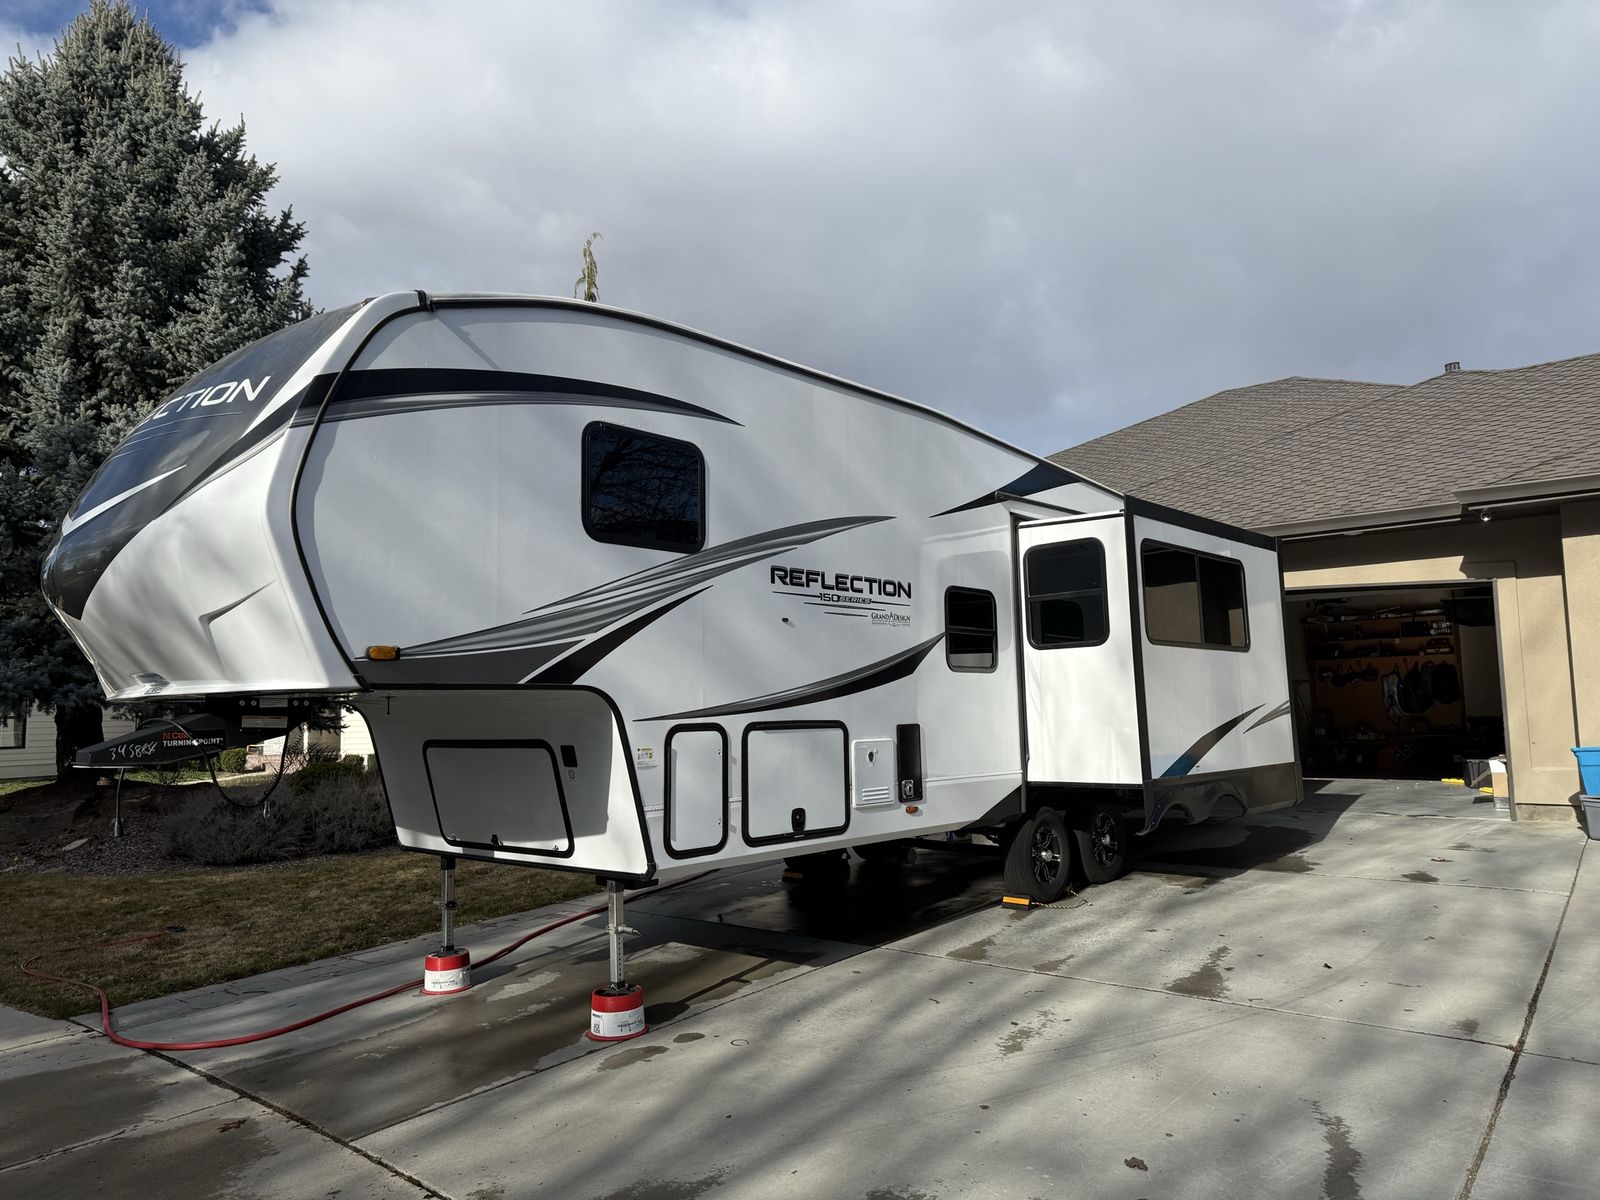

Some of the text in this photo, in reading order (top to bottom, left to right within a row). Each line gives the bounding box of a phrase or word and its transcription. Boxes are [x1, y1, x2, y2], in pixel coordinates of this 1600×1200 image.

[147, 375, 271, 420] CTION
[770, 565, 912, 599] REFLECTION
[819, 592, 840, 602] 150
[200, 737, 221, 745] POINT
